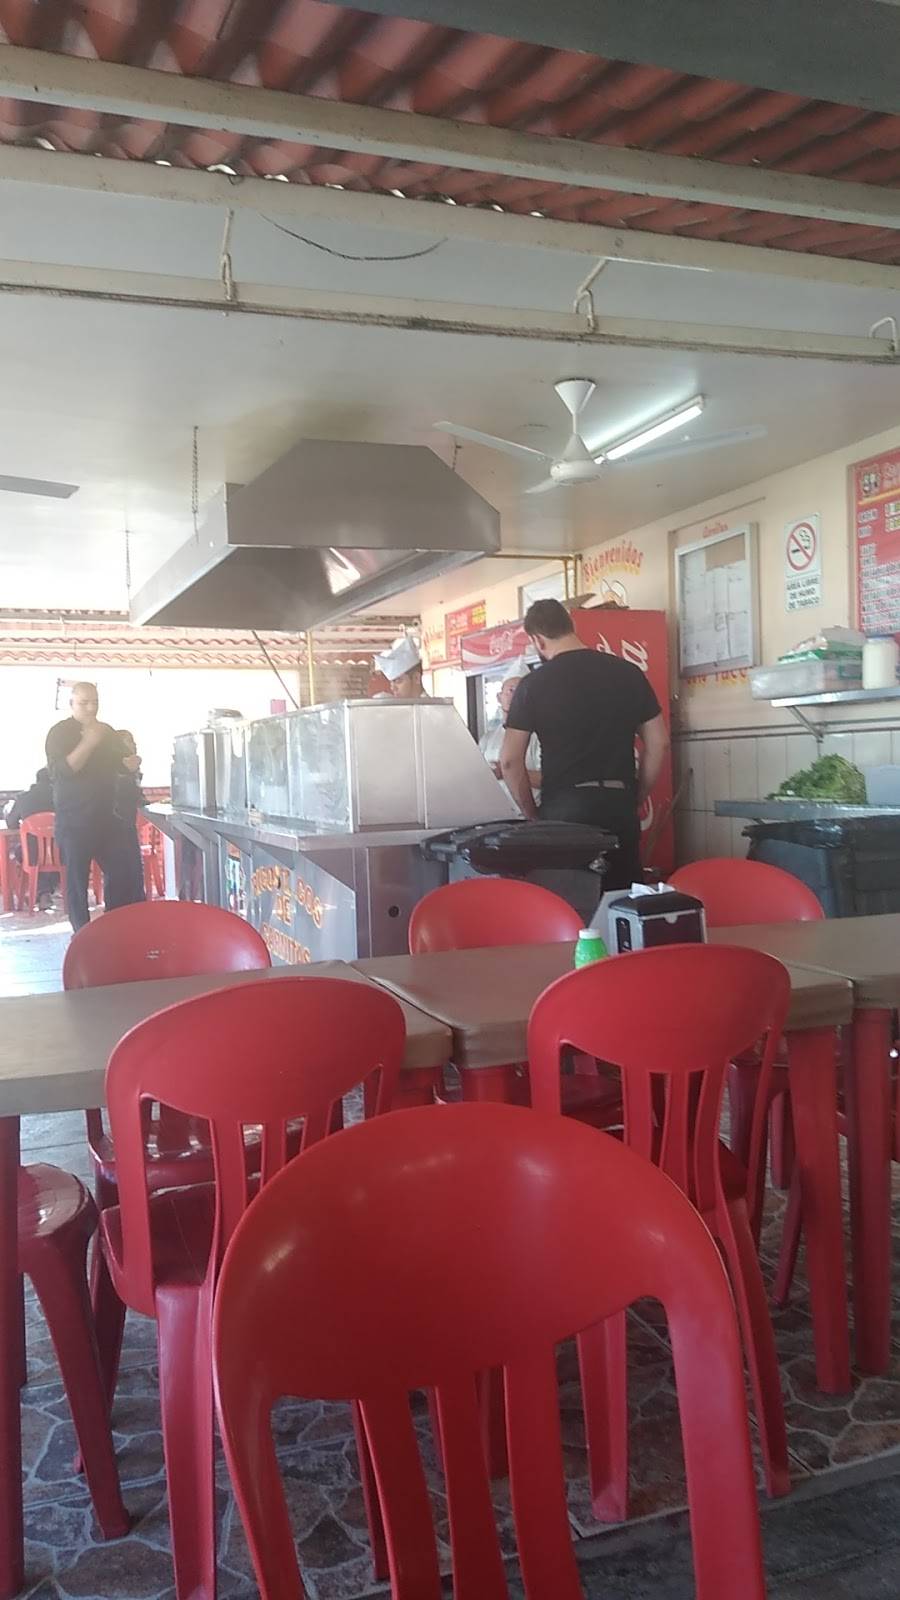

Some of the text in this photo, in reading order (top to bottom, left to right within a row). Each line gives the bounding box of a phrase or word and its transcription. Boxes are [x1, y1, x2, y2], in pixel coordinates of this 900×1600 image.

[583, 539, 644, 583] Bienvenidos
[802, 577, 819, 587] LIBRE
[789, 587, 816, 600] DE HUMO
[788, 596, 820, 610] DE TABACO
